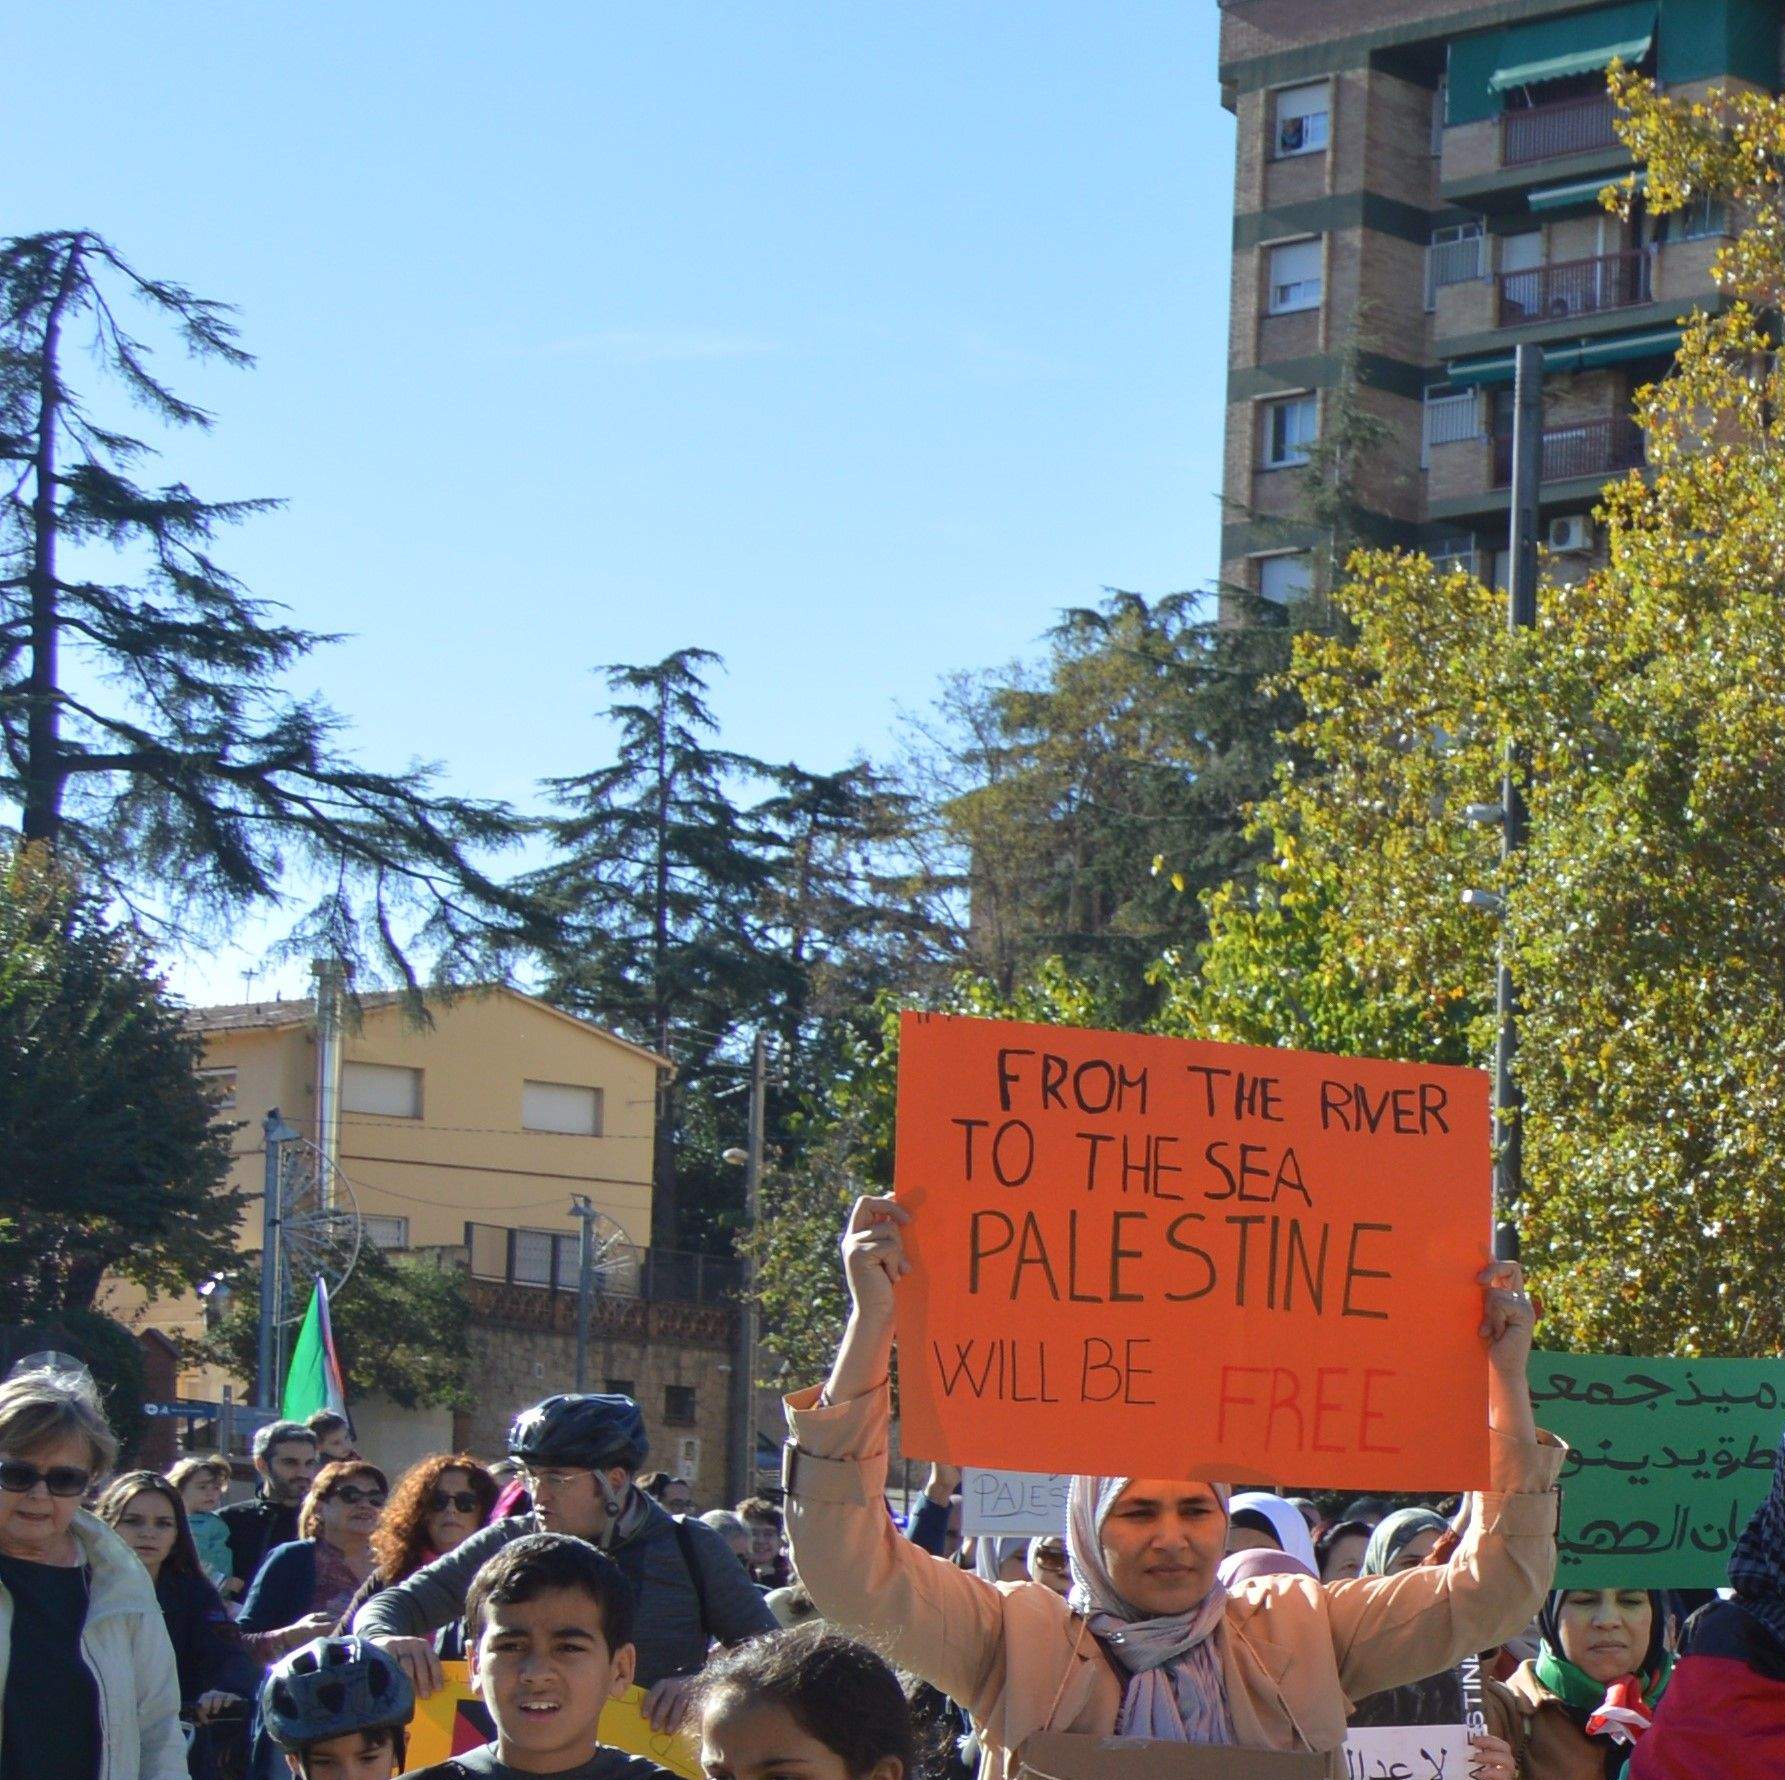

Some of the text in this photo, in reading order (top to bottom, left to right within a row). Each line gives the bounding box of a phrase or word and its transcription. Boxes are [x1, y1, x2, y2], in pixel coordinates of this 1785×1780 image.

[998, 1048, 1450, 1135] FROM THE RIVER
[952, 1118, 1313, 1207] TO THE SEA
[970, 1209, 1393, 1320] PALESTINE
[933, 1337, 1402, 1454] WILL BE FREE
